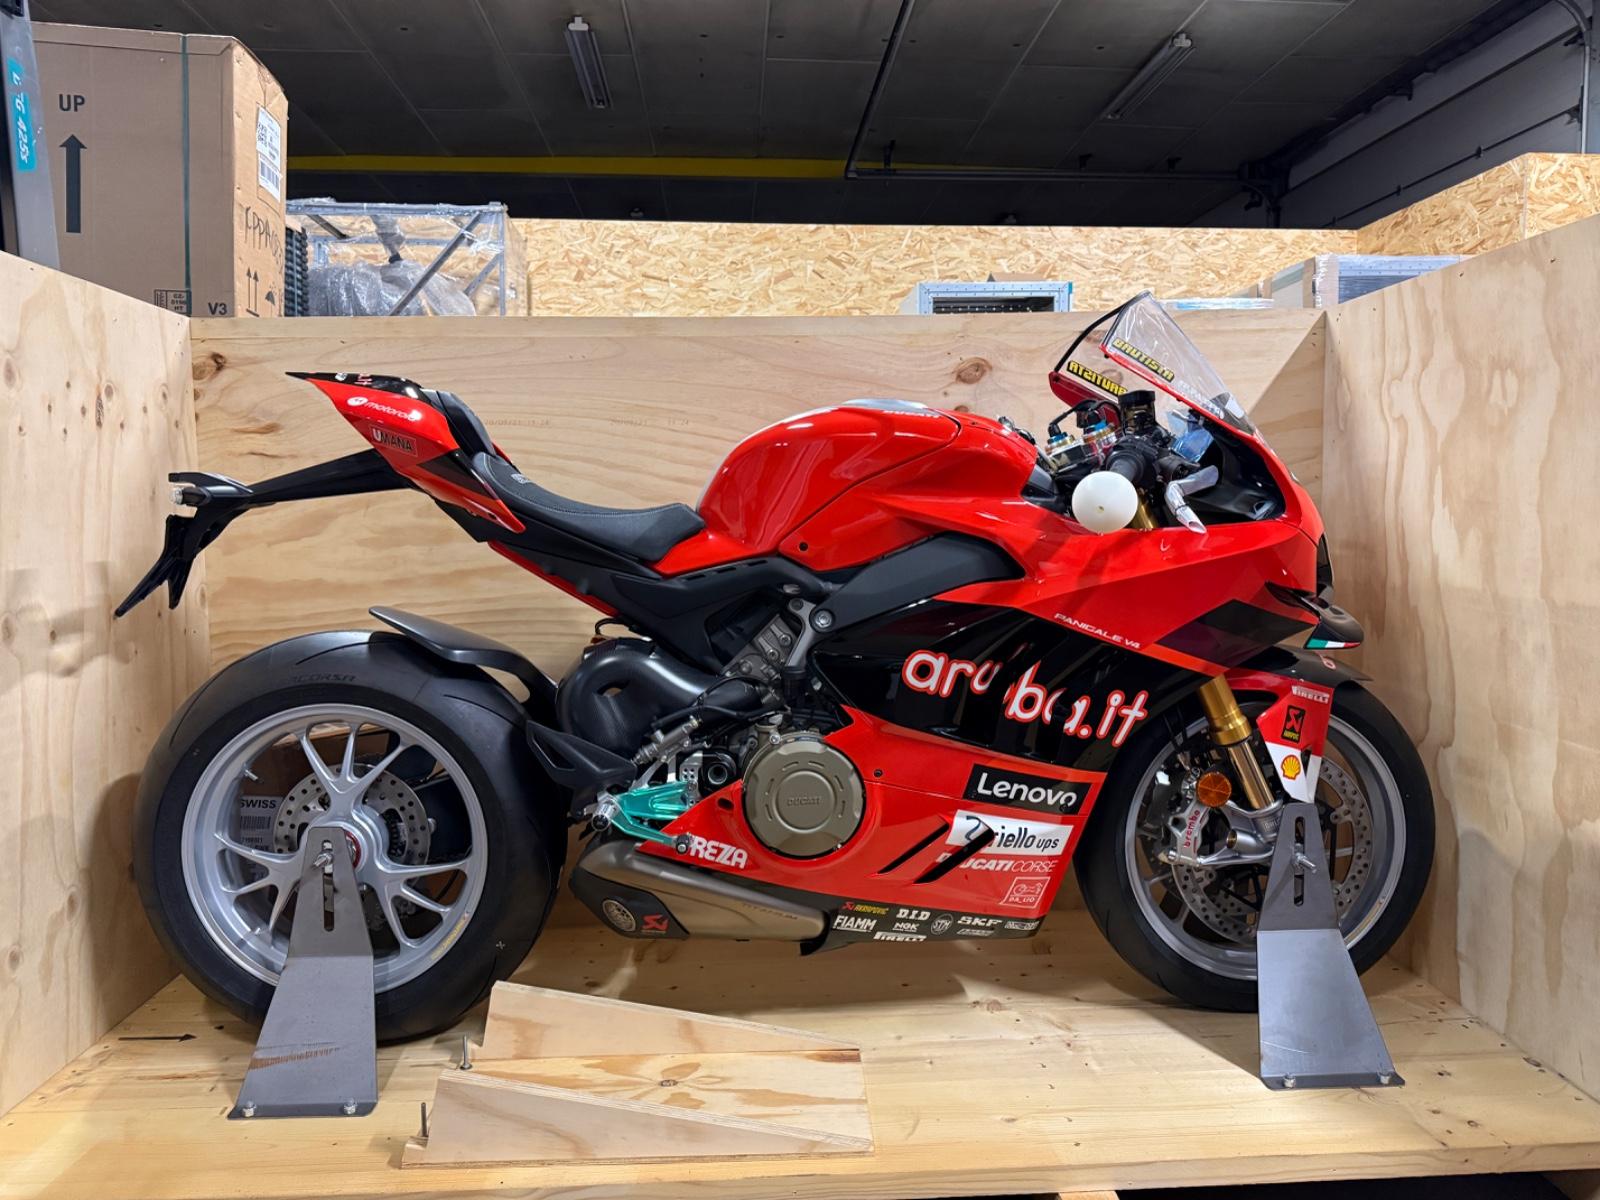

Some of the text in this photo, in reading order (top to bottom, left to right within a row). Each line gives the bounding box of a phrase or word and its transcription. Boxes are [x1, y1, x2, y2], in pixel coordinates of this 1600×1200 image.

[58, 94, 85, 112] UP
[208, 302, 228, 316] V3
[1112, 338, 1175, 382] BAUTISTA
[372, 428, 412, 450] UMANA
[1054, 612, 1141, 649] PANIGALE V4
[1291, 685, 1330, 704] PIRELLI
[976, 772, 1077, 808] Lenovo
[240, 799, 277, 809] SWISS
[1183, 809, 1201, 848] brembo
[1036, 838, 1060, 853] ups
[832, 915, 878, 931] FIAMM
[893, 922, 920, 932] NGK
[957, 916, 1003, 927] SKF
